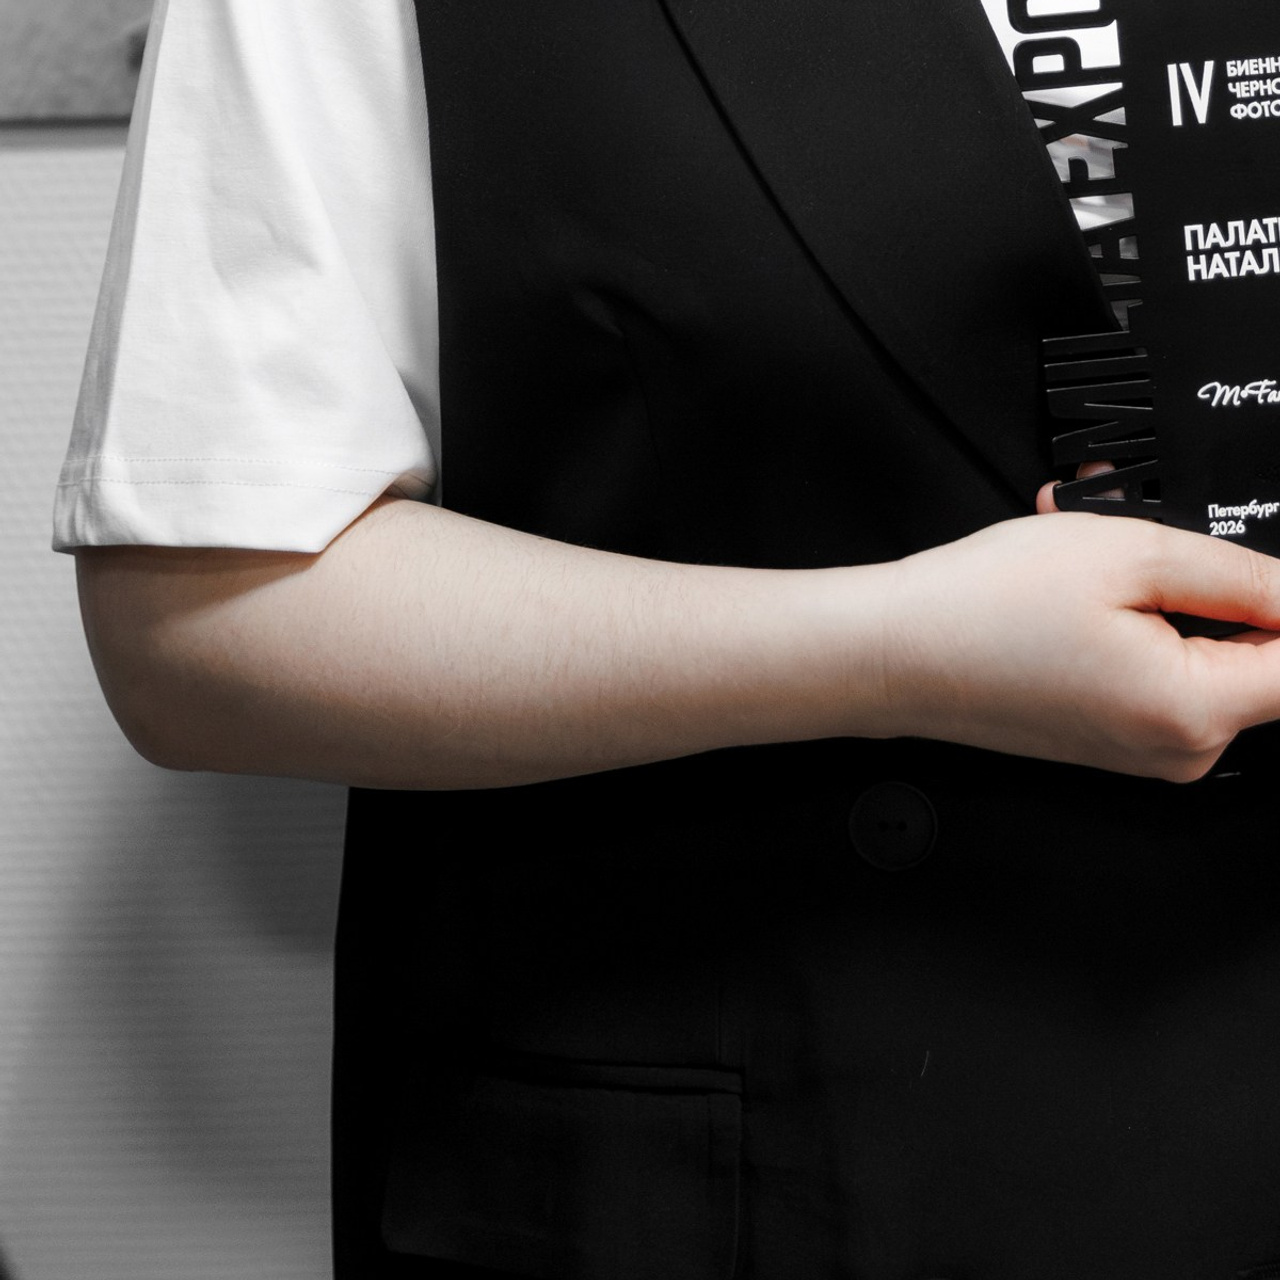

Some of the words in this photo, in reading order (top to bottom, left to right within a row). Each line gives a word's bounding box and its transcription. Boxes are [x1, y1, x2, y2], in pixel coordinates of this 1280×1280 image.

[1166, 59, 1215, 127] IV
[1207, 498, 1280, 520] Петербург
[1208, 519, 1246, 536] 2026
